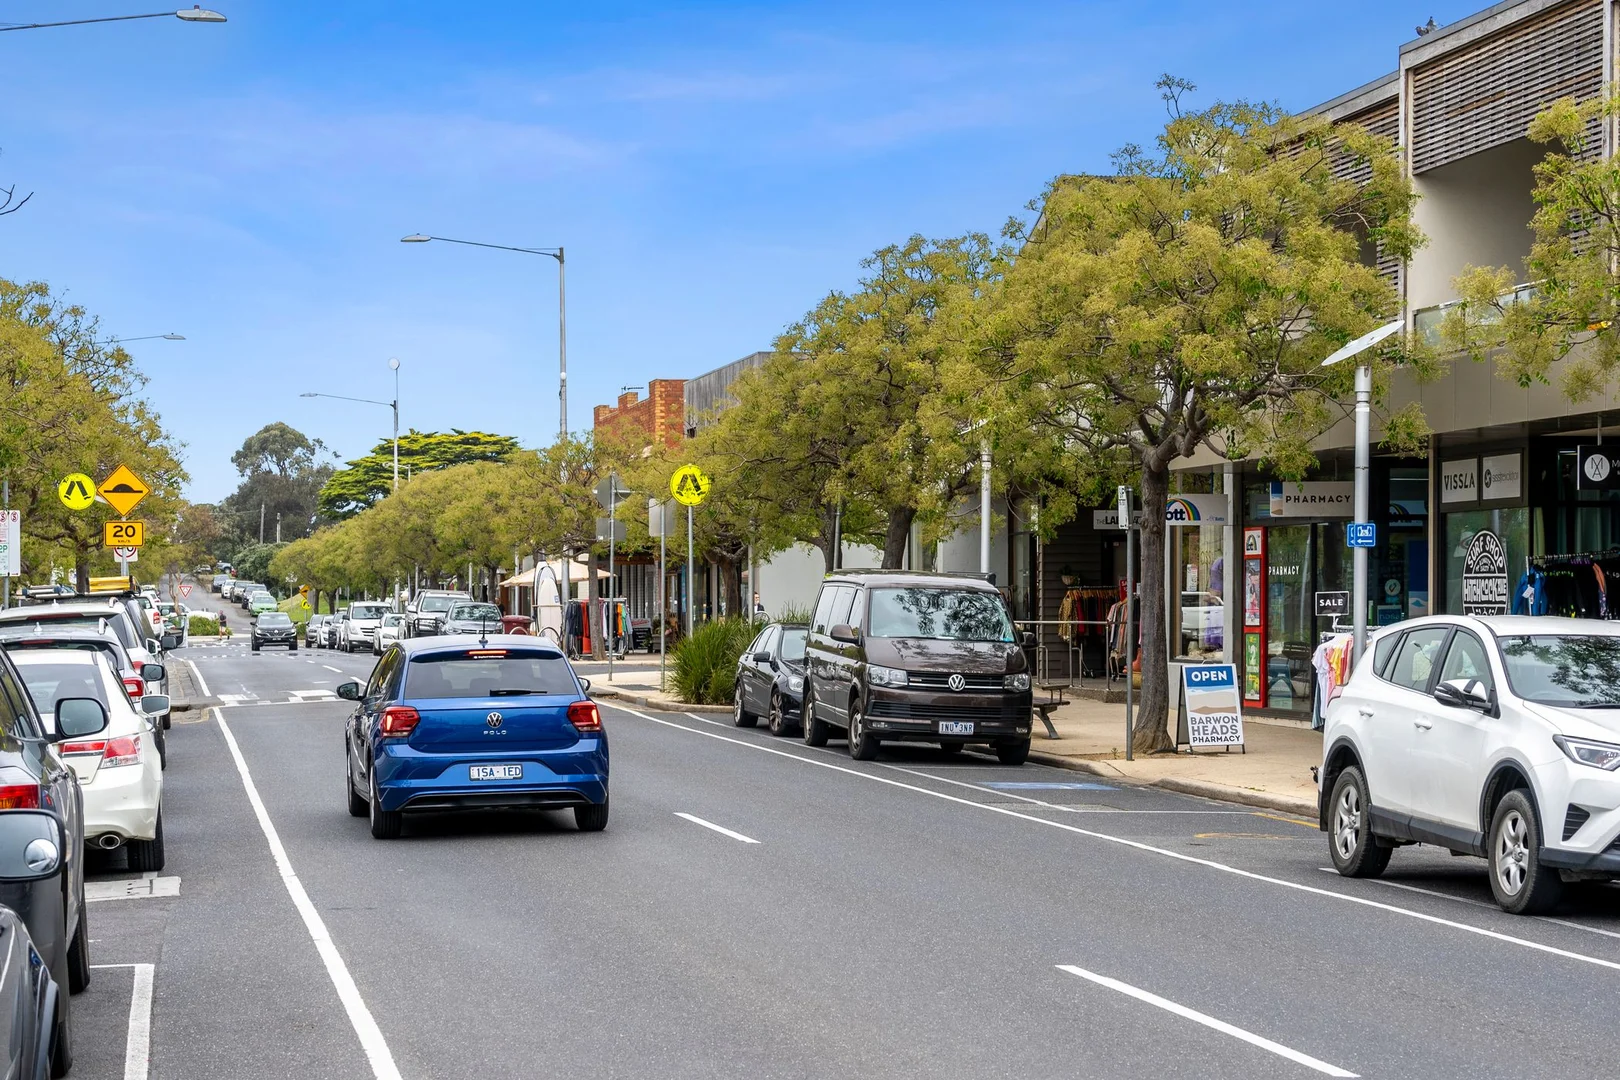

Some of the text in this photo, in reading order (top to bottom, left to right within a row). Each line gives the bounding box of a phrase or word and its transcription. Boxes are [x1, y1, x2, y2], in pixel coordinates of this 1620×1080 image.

[1444, 472, 1475, 490] VISSLA
[1285, 495, 1351, 503] PHARMACY
[1165, 508, 1186, 521] ott
[113, 525, 136, 538] 20
[1467, 535, 1504, 568] SURF SHOP
[1268, 565, 1300, 576] PHARMACY
[1464, 578, 1498, 603] HITCHCOCK
[1191, 670, 1227, 681] OPEN
[1190, 715, 1239, 725] BARWON
[1191, 724, 1239, 736] HEADS
[1192, 735, 1241, 743] PHARMACY
